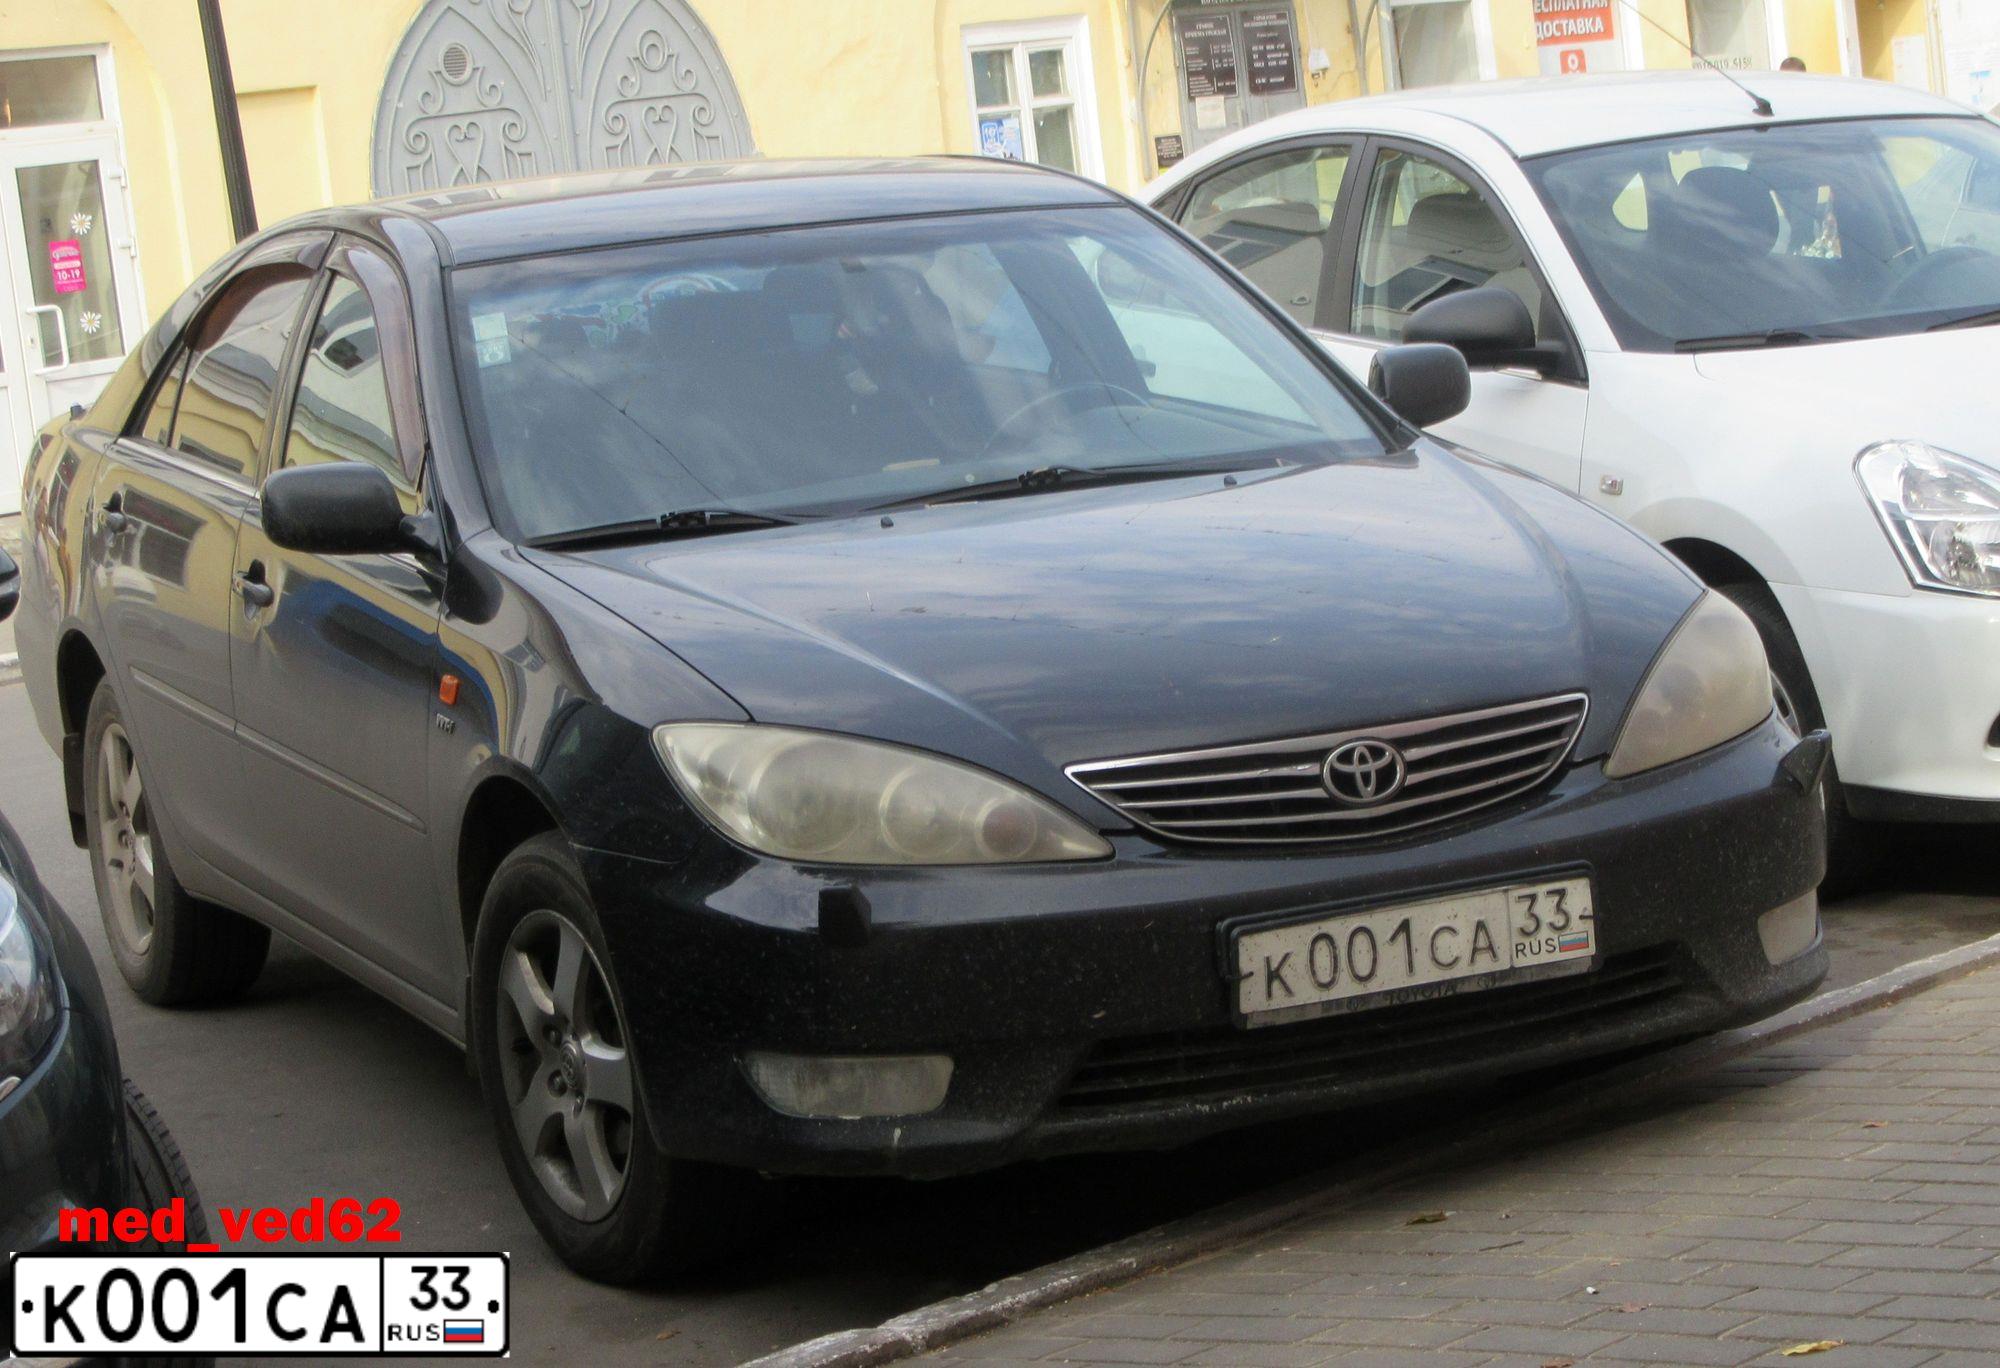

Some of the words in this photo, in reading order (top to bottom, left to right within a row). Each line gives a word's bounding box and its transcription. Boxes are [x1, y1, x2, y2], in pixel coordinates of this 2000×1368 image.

[1536, 17, 1604, 40] ДОСТАВКА
[1514, 887, 1571, 937] 33
[1514, 936, 1557, 959] RUS
